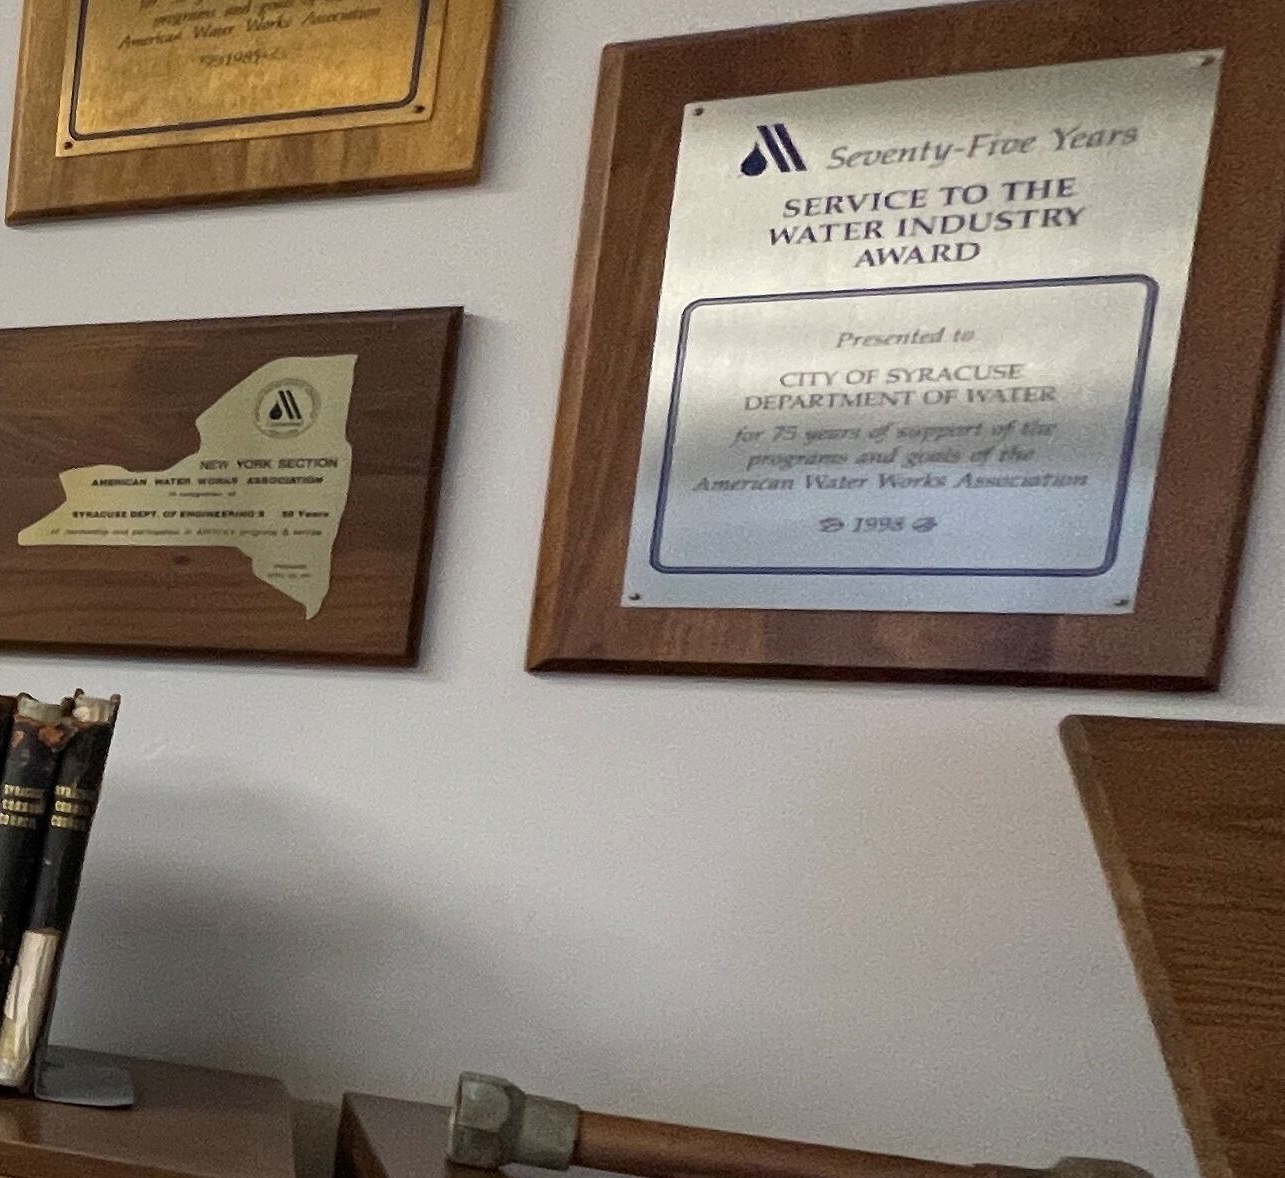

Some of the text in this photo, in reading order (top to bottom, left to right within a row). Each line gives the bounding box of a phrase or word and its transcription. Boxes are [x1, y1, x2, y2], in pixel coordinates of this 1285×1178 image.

[827, 125, 1140, 170] Seventy-Five Years
[782, 177, 1078, 218] SERVICE TO THE
[769, 206, 1087, 246] WATER INDUSTRY
[854, 240, 982, 269] AWARD
[835, 327, 977, 349] Presented to
[779, 363, 1027, 388] CITY OF SYRACUSE
[743, 385, 1058, 412] DEPARTMENT OF WATER
[199, 457, 338, 471] NEW YORK SECTION
[691, 471, 1089, 493] American Water Works Association
